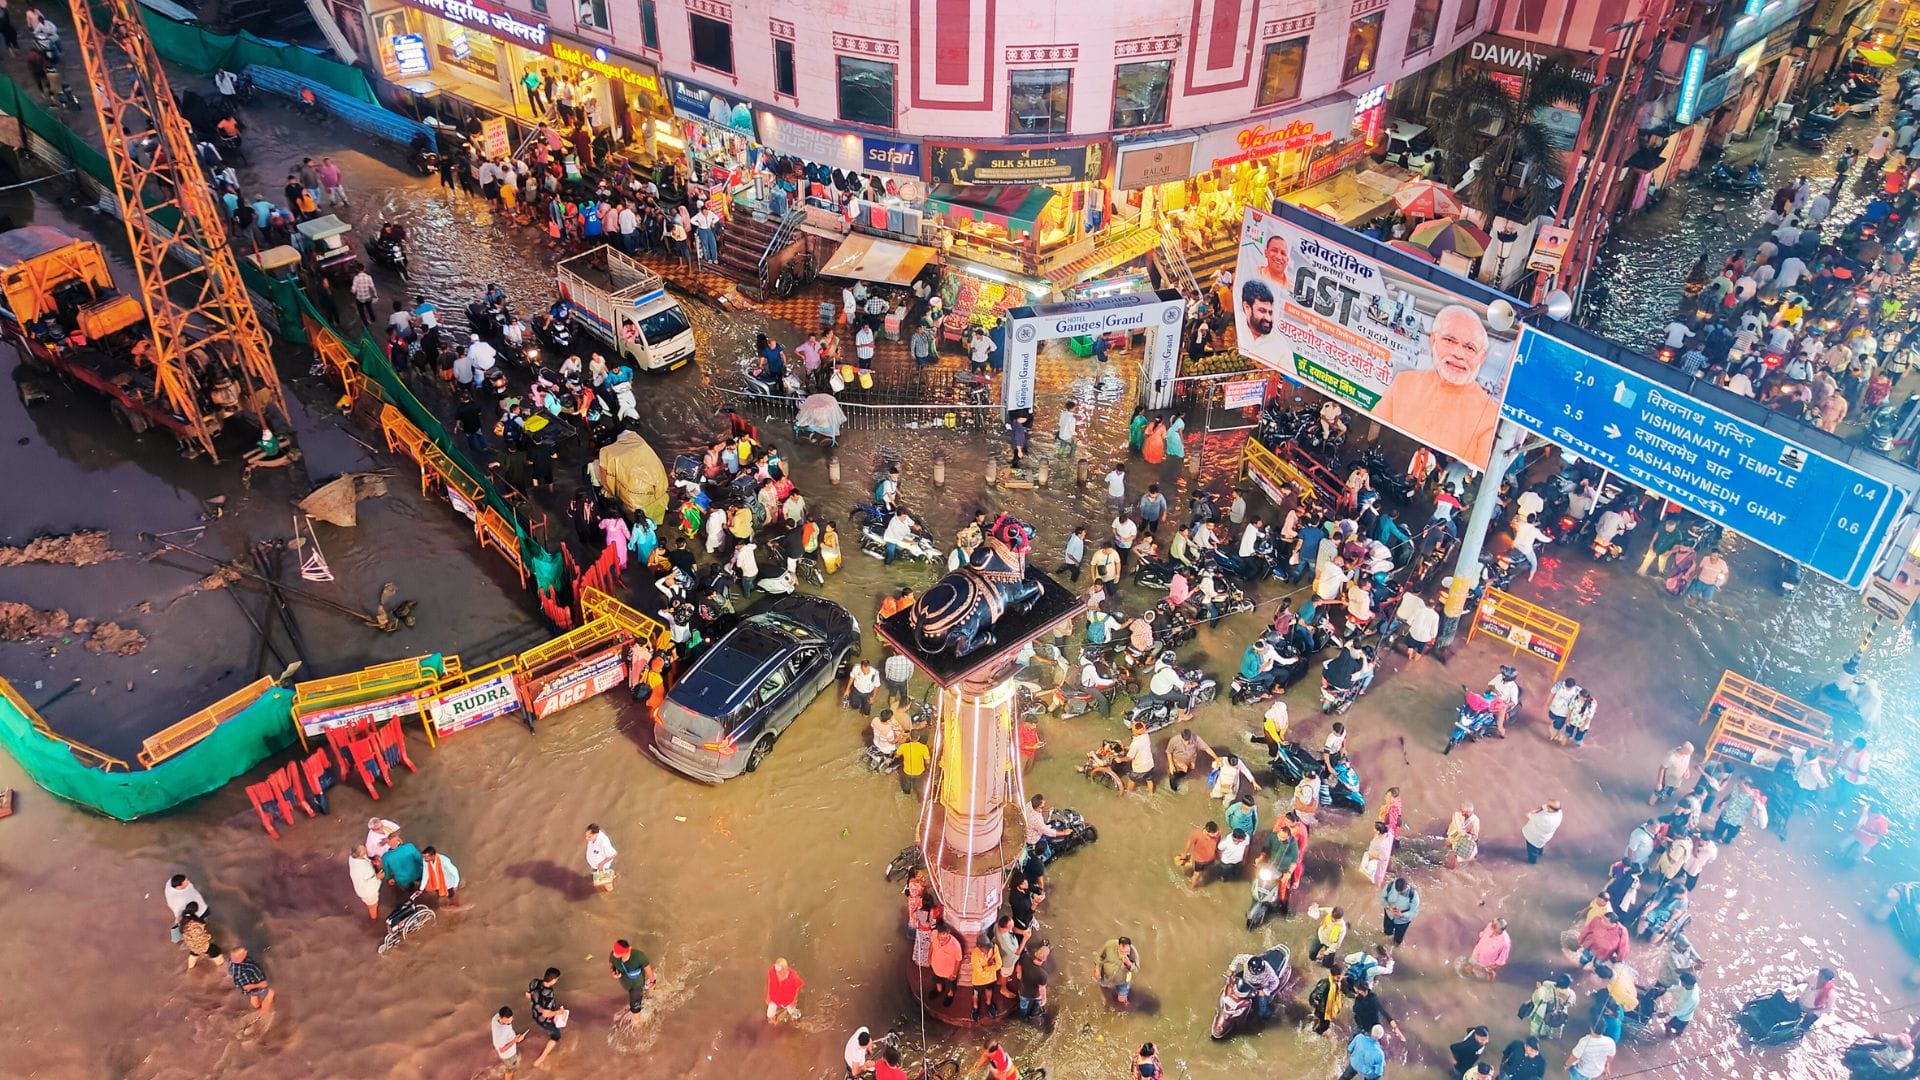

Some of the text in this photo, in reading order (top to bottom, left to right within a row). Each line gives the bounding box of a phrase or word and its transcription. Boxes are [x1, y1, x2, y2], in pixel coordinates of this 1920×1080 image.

[491, 10, 546, 45] ज्वेलर्स
[552, 42, 658, 92] Hotel Ganges Grand
[1470, 41, 1547, 71] DAWAT
[677, 85, 703, 102] Amul
[688, 113, 710, 126] TRADING
[772, 118, 850, 148] MERICA
[769, 129, 859, 161] OURISTE
[1237, 120, 1314, 150] Varnika
[869, 148, 914, 166] safari
[991, 158, 1057, 168] SILK SAREES
[1143, 166, 1170, 176] BALAJI
[1299, 237, 1376, 279] इलेक्ट्रॉनिक
[1344, 274, 1356, 285] पर
[1293, 266, 1362, 327] GST
[1056, 312, 1144, 334] Ganges Grand
[1067, 315, 1086, 323] HOTEL
[1162, 334, 1174, 359] Grand
[1278, 319, 1324, 352] आदरणीय
[1324, 340, 1350, 366] नरेन्द्र
[1350, 352, 1375, 378] मोदी
[1375, 364, 1393, 386] जी
[1018, 353, 1029, 378] Grand
[1298, 358, 1308, 373] डॉ.
[1514, 354, 1595, 387] A 2.0
[1016, 379, 1029, 408] Ganges
[1563, 403, 1584, 421] 3.5
[1646, 388, 1757, 448] विश्वनाथ मन्दिर
[1501, 402, 1543, 428] र्माण
[1628, 463, 1728, 517] वाराणसी
[1634, 426, 1734, 481] दशाश्वमेध घाट
[1640, 409, 1876, 501] VISHWANATH TEMPLE 0.4
[1626, 444, 1860, 534] DASHASHVMEDH GHAT 0.6
[453, 685, 510, 715] RUDRA
[540, 683, 588, 719] ACC
